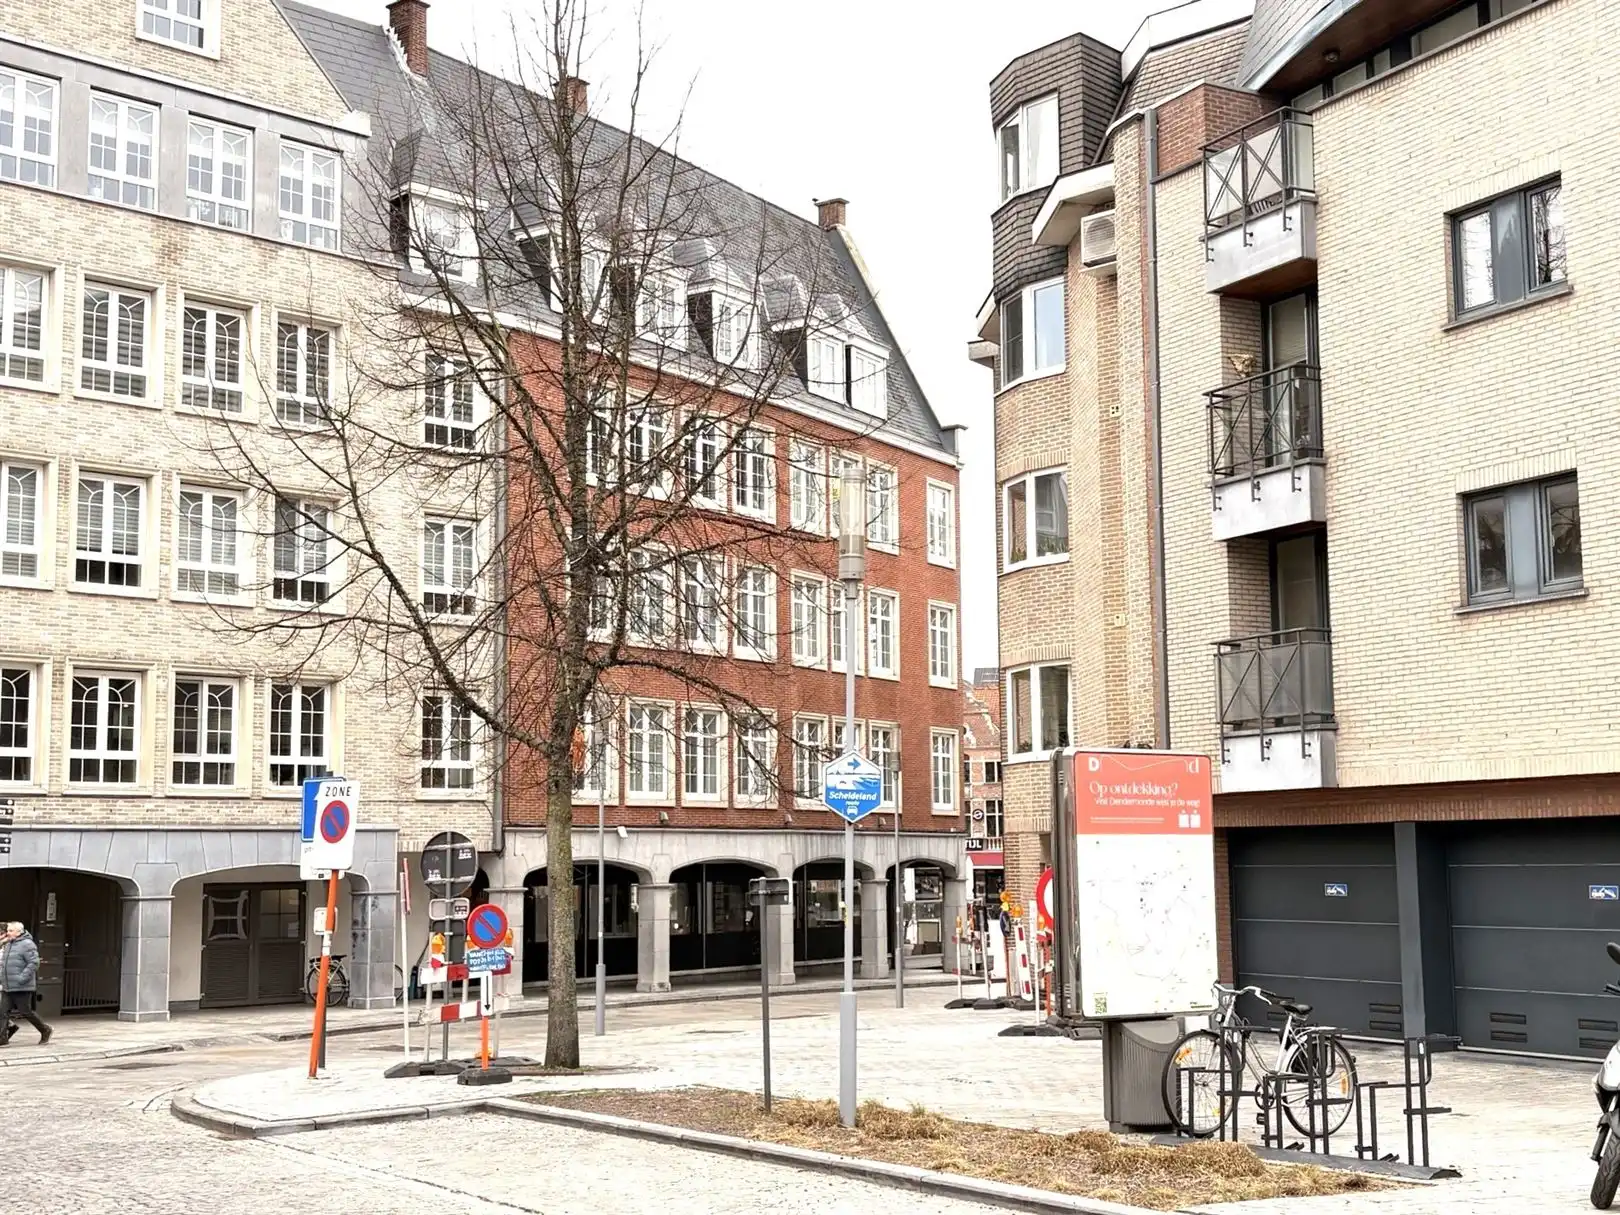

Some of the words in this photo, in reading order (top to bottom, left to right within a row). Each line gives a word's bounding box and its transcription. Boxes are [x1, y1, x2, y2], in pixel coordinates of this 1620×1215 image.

[1088, 757, 1100, 771] D
[325, 786, 352, 797] ZONE
[1089, 781, 1108, 798] Op
[1110, 781, 1178, 798] ontdekking?
[829, 791, 877, 801] Scheldeland
